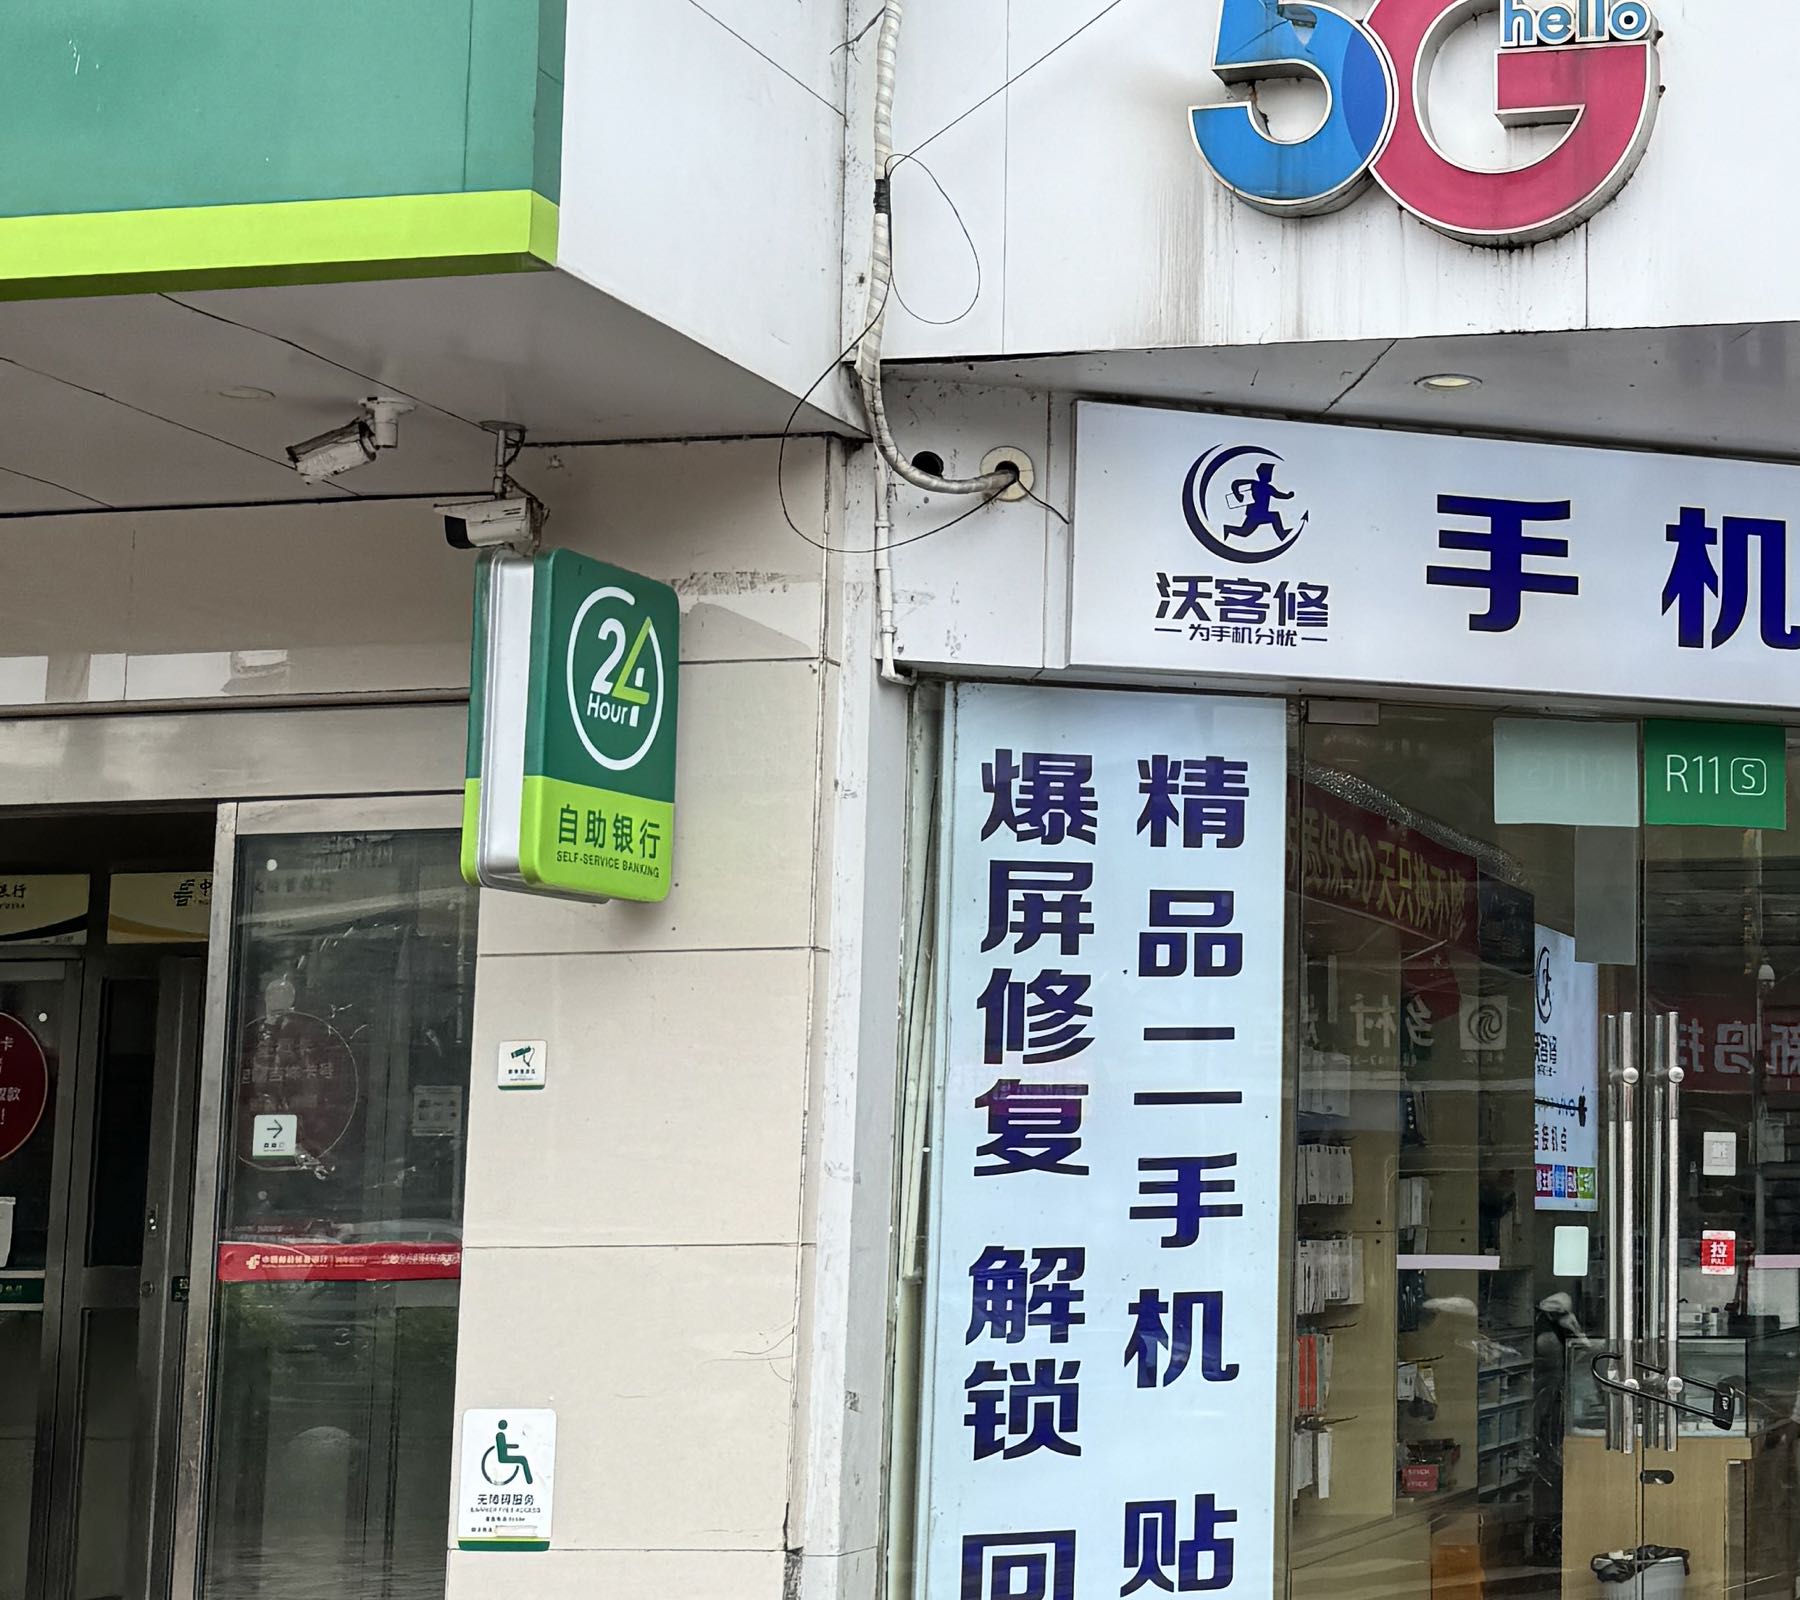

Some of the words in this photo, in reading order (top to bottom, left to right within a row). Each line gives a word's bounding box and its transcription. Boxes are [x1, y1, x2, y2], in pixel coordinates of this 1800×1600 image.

[1155, 572, 1329, 628] 沃客修
[1188, 623, 1298, 647] 为手机分忧
[590, 616, 650, 727] 24
[586, 693, 628, 725] Hour
[557, 803, 661, 860] 自助银行
[557, 850, 620, 870] SELF-SERVICE
[622, 860, 660, 879] BANKING
[973, 748, 1099, 1177] 爆屏修复
[1123, 753, 1251, 1389] 精品二手机
[1710, 1241, 1728, 1257] 拉
[963, 1245, 1086, 1462] 解锁
